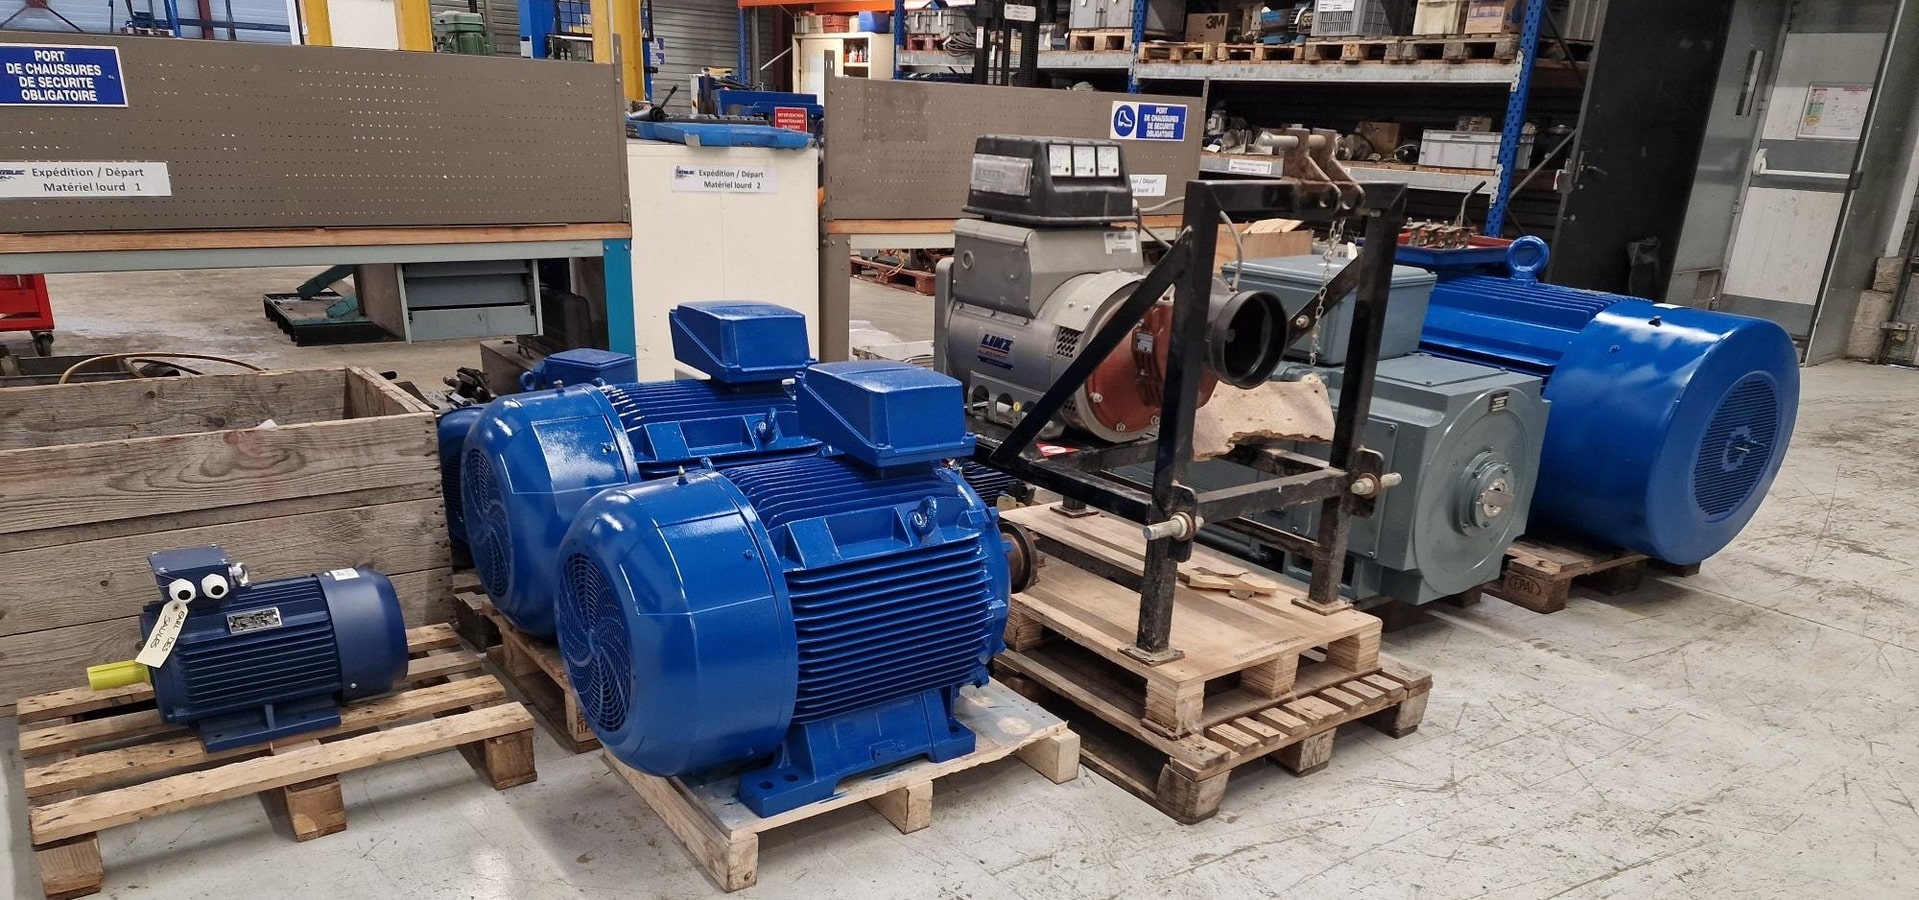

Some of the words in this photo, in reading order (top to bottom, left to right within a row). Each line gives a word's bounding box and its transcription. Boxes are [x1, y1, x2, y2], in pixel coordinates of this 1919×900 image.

[1206, 15, 1226, 29] 3M
[34, 50, 65, 61] PORT
[6, 63, 22, 74] DE
[25, 63, 101, 76] CHAUSSURES
[19, 76, 36, 87] DE
[38, 77, 95, 88] SECURITE
[21, 89, 98, 101] OBLIGATOIRE
[1151, 115, 1179, 123] CHAUSSURES
[1147, 122, 1154, 130] DE
[1146, 130, 1174, 138] OBLIGATOIRE
[32, 167, 94, 179] Expédition
[97, 167, 102, 178] /
[105, 168, 144, 178] Départ
[699, 169, 734, 179] Expédition
[741, 171, 764, 179] Départ
[43, 182, 93, 192] Matériel
[95, 182, 126, 192] lourd
[135, 183, 142, 192] 1
[704, 180, 733, 189] Matériel
[982, 334, 1013, 351] LINZ
